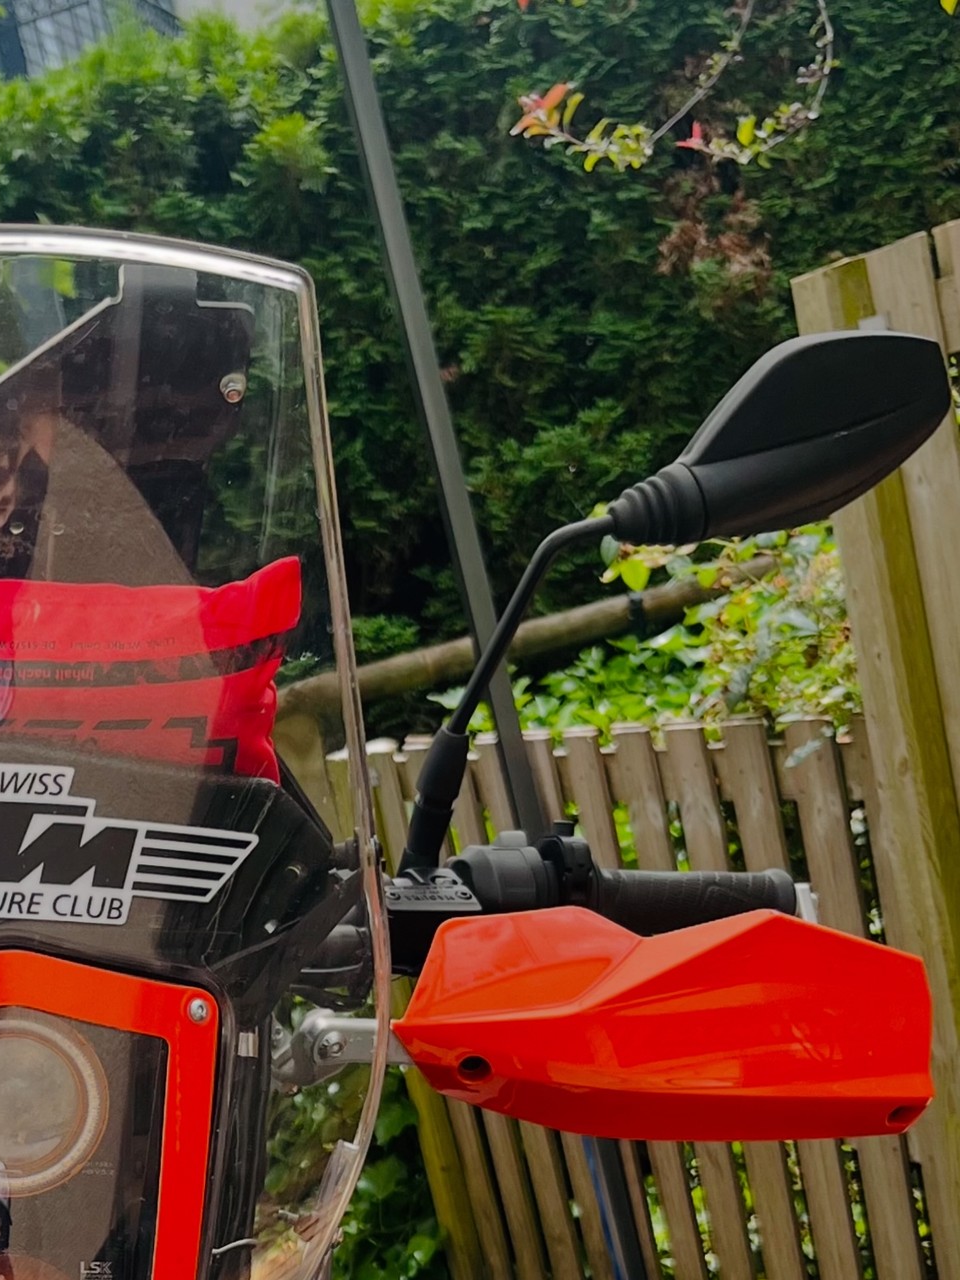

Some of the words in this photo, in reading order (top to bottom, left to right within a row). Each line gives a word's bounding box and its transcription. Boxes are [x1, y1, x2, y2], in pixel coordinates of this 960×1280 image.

[18, 668, 51, 680] nach
[55, 667, 94, 682] Inhalt
[52, 893, 124, 920] CLUB
